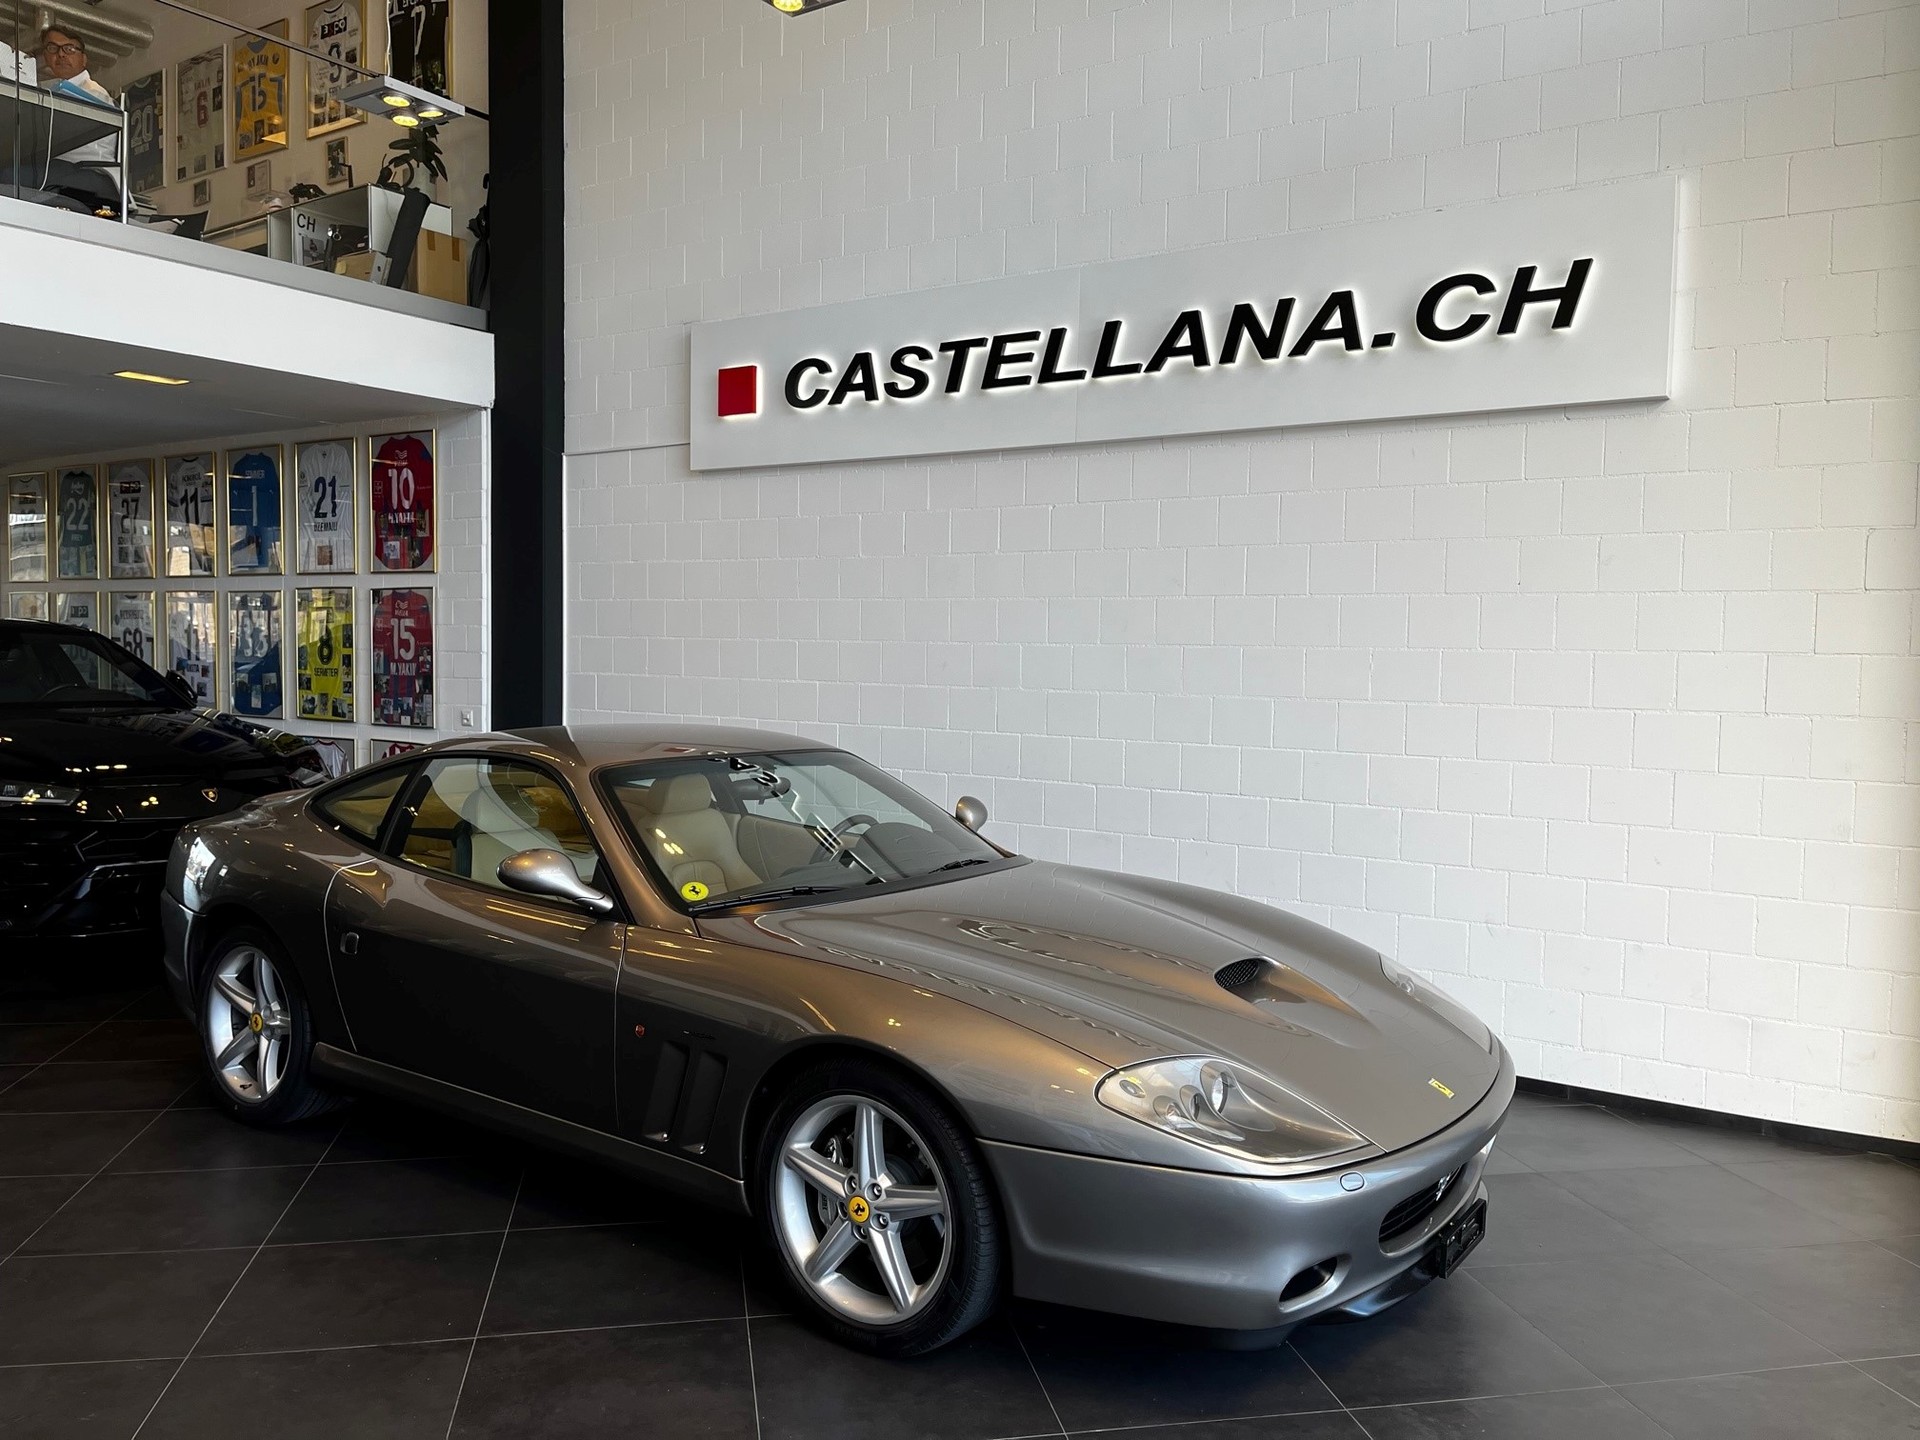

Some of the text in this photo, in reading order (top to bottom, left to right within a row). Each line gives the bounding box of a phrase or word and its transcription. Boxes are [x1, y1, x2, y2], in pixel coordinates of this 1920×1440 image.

[411, 5, 426, 55] 7
[252, 72, 267, 112] 15
[130, 104, 154, 148] 20
[297, 213, 316, 233] CH
[784, 257, 1594, 410] CASTELLANA.CH
[180, 487, 200, 525] 11
[314, 475, 337, 518] 21
[388, 467, 415, 510] 10
[66, 497, 89, 531] 22
[121, 497, 140, 534] 27
[123, 627, 144, 660] 68
[390, 617, 416, 661] 15
